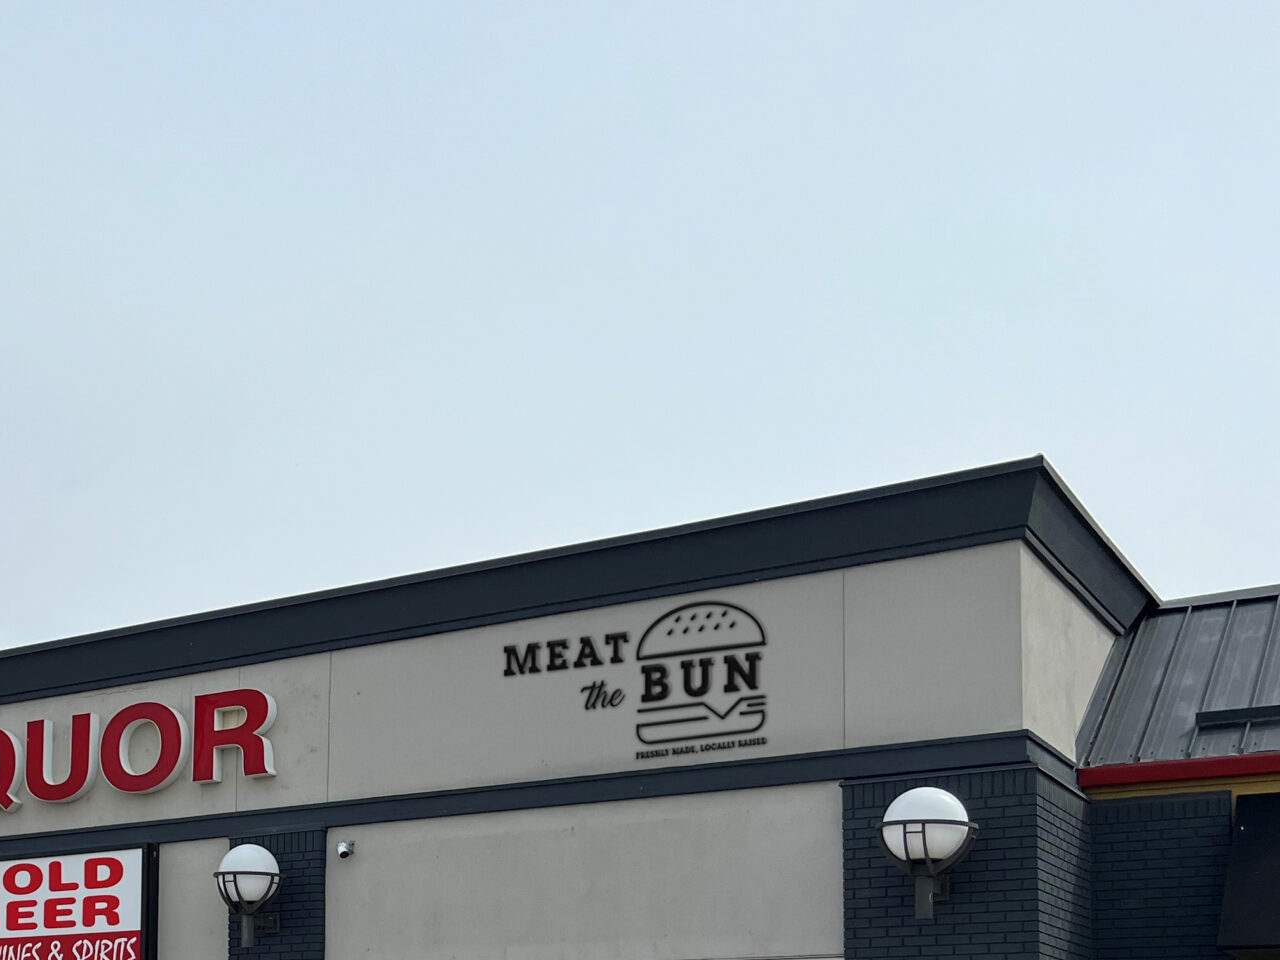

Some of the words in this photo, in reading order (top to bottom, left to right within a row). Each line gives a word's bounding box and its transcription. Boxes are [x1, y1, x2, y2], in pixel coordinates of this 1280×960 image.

[503, 632, 629, 677] MEAT
[581, 681, 626, 710] the
[640, 652, 762, 704] BUN
[636, 749, 669, 760] FRESHLY
[700, 741, 735, 752] LOCALLY
[737, 737, 767, 748] RAISED
